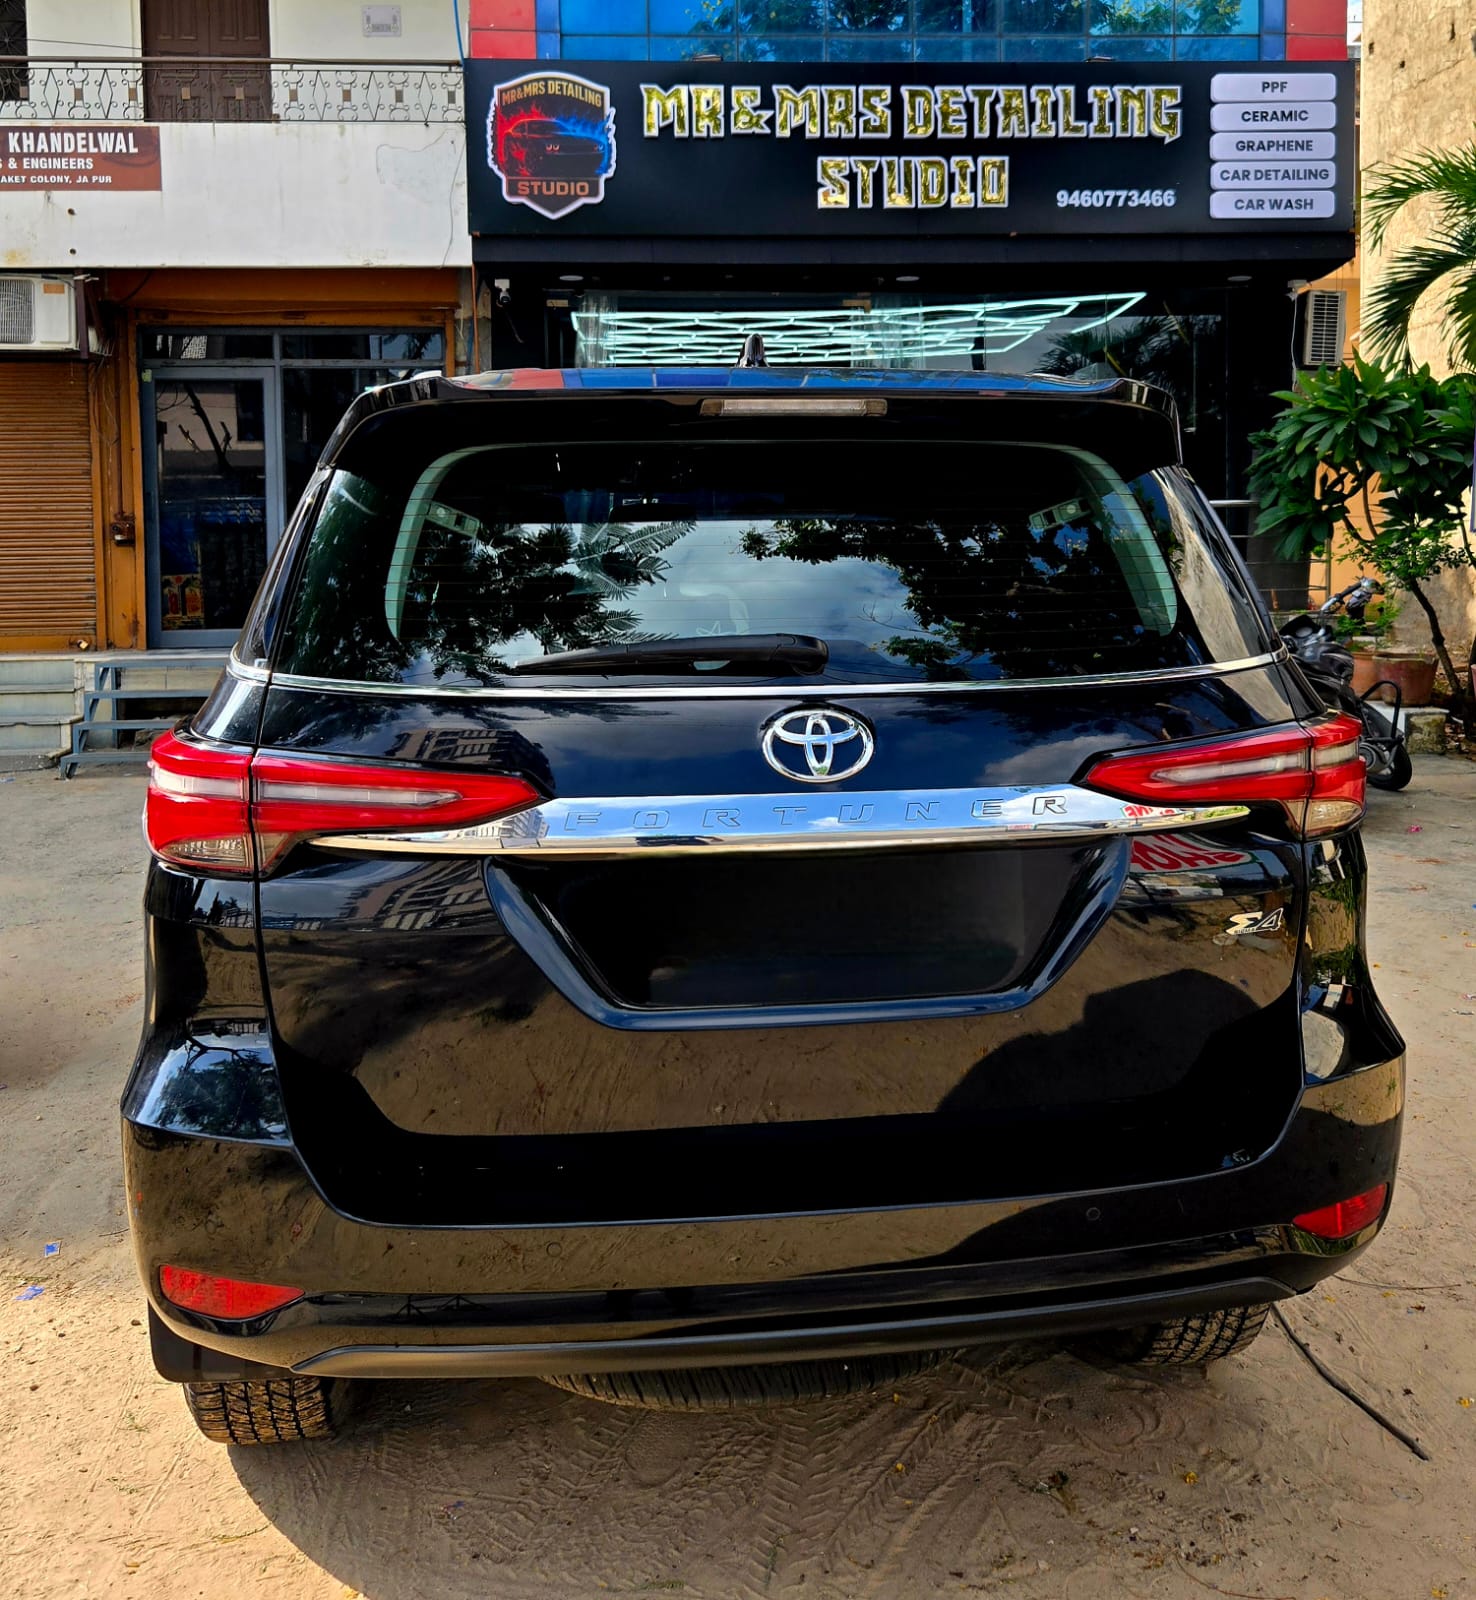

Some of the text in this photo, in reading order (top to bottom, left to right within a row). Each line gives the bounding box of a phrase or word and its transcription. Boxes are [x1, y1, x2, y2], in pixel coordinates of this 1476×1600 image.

[502, 80, 602, 107] MR&MRS DETAILING
[1261, 81, 1288, 93] PPF
[900, 85, 1182, 145] DETAILING
[1241, 110, 1309, 122] CERAMIC
[8, 132, 139, 153] KHANDELWAL
[1235, 140, 1313, 152] GRAPHENE
[8, 157, 17, 169] &
[23, 157, 94, 170] ENGINEERS
[30, 175, 72, 184] COLONY,
[1220, 168, 1329, 181] CAR DETAILING
[517, 181, 590, 196] STUDIO
[817, 156, 1009, 208] STUDIO
[1056, 189, 1177, 208] 9460773466
[1234, 198, 1314, 211] CAR WASH
[564, 795, 1068, 831] FORTUNER
